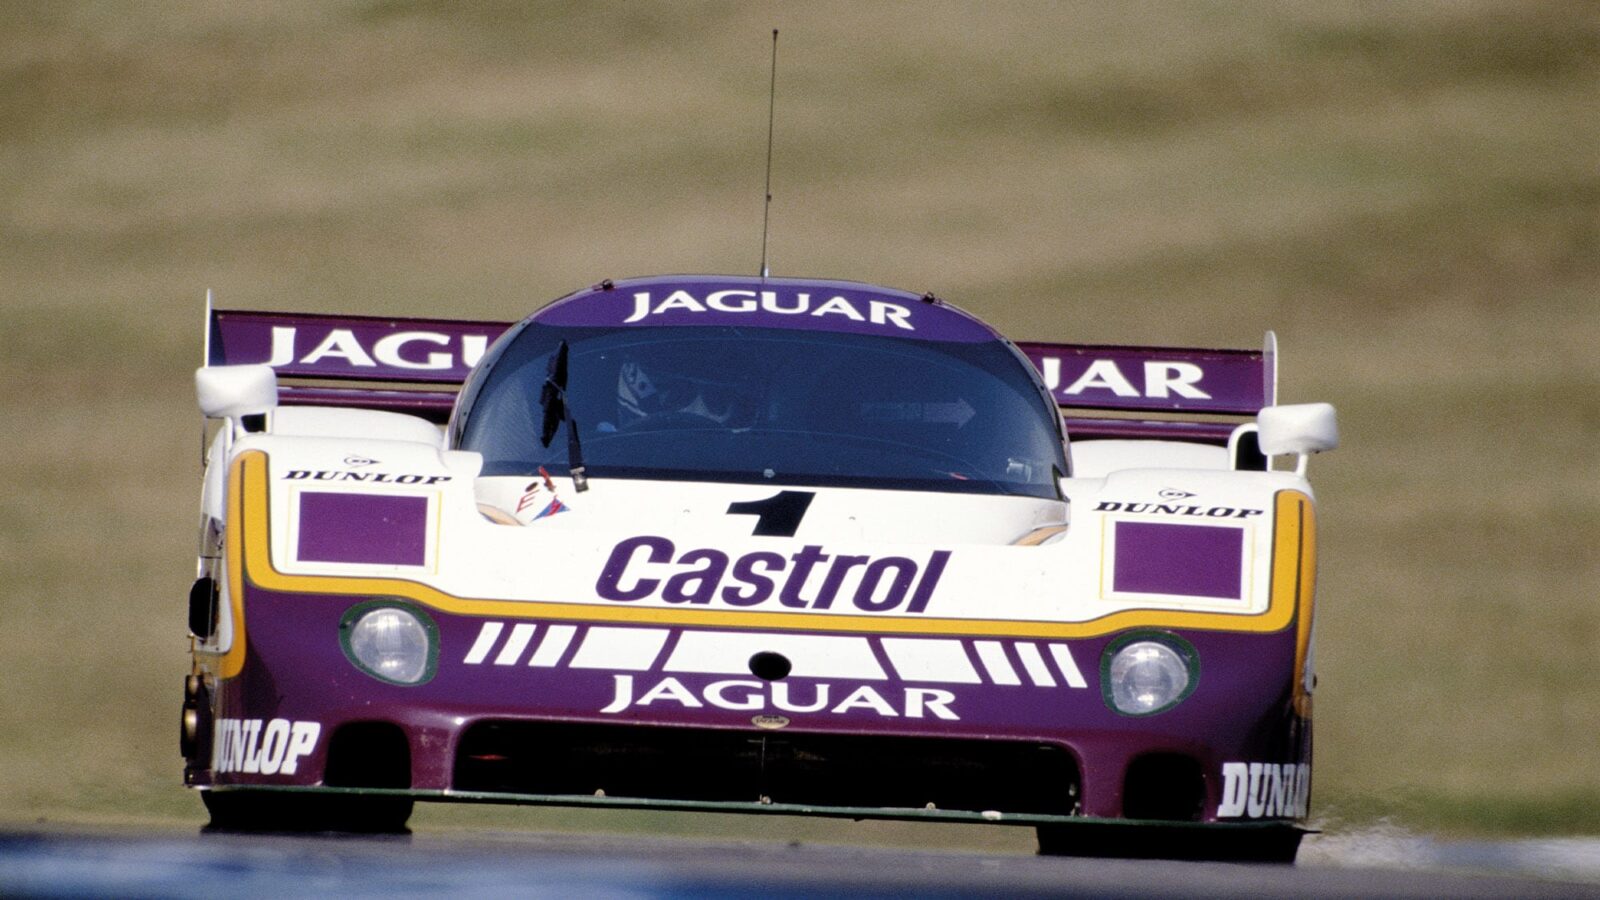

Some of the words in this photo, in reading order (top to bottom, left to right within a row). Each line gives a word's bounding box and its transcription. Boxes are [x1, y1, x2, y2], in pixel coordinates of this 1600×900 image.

[623, 290, 915, 330] JAGUAR
[281, 470, 452, 485] DUNLOP
[725, 490, 816, 537] 1
[1093, 502, 1264, 519] DUNLOP
[595, 535, 952, 613] Castrol
[600, 674, 960, 720] JAGUAR
